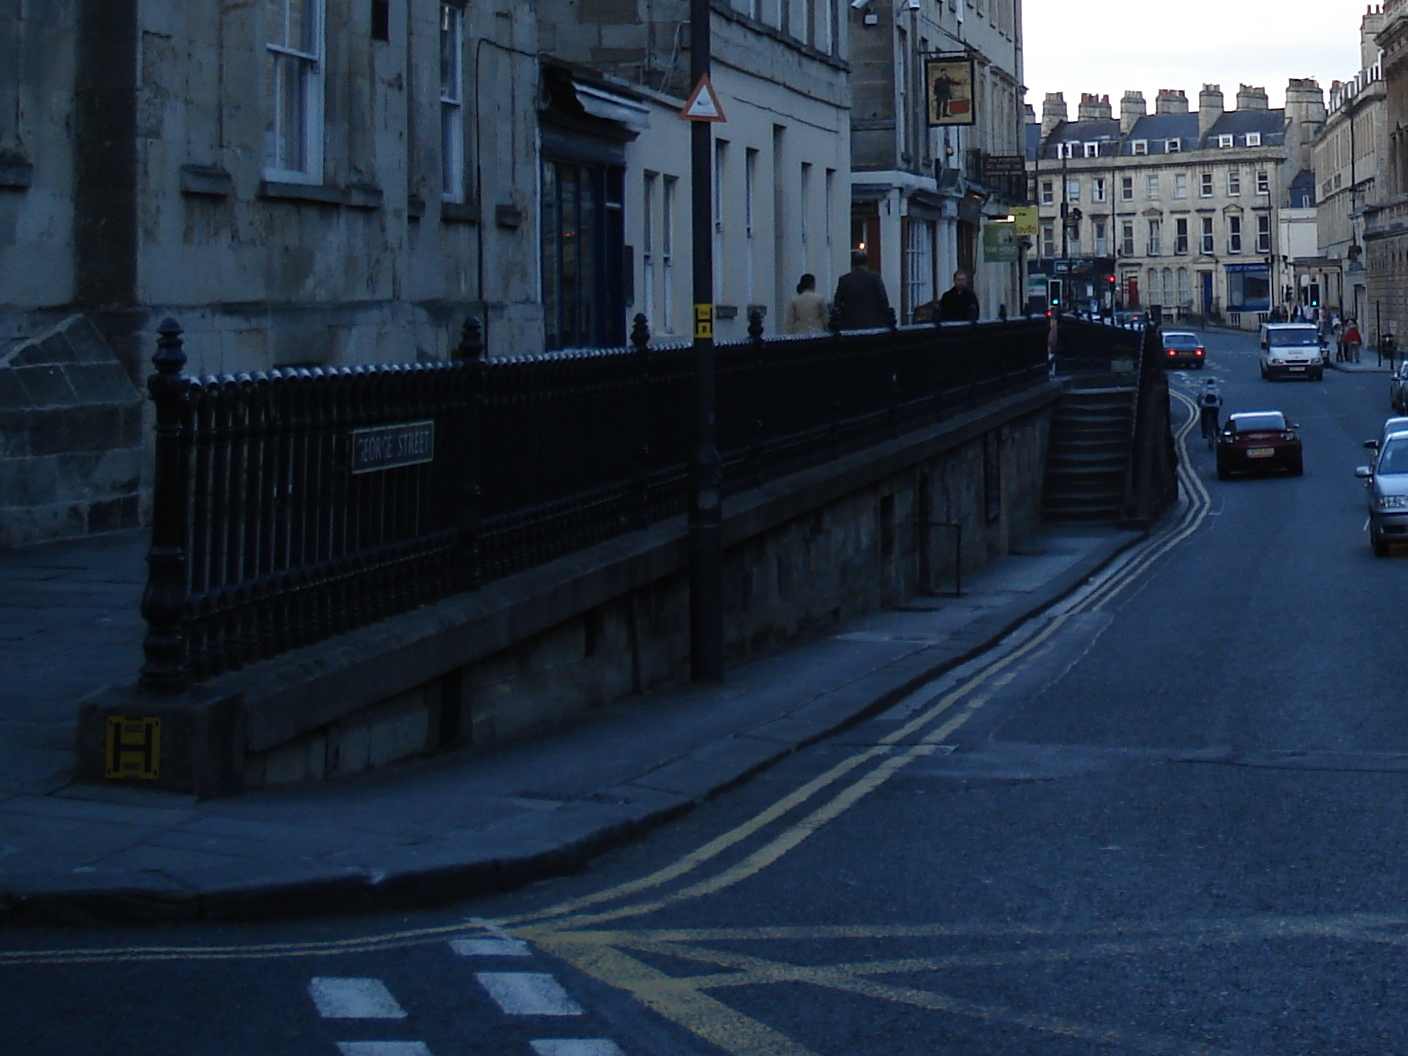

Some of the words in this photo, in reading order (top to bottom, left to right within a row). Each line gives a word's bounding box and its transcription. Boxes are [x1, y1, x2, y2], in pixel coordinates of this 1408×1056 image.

[357, 435, 393, 462] GEORGE
[398, 430, 430, 456] STREET
[113, 722, 152, 774] H
